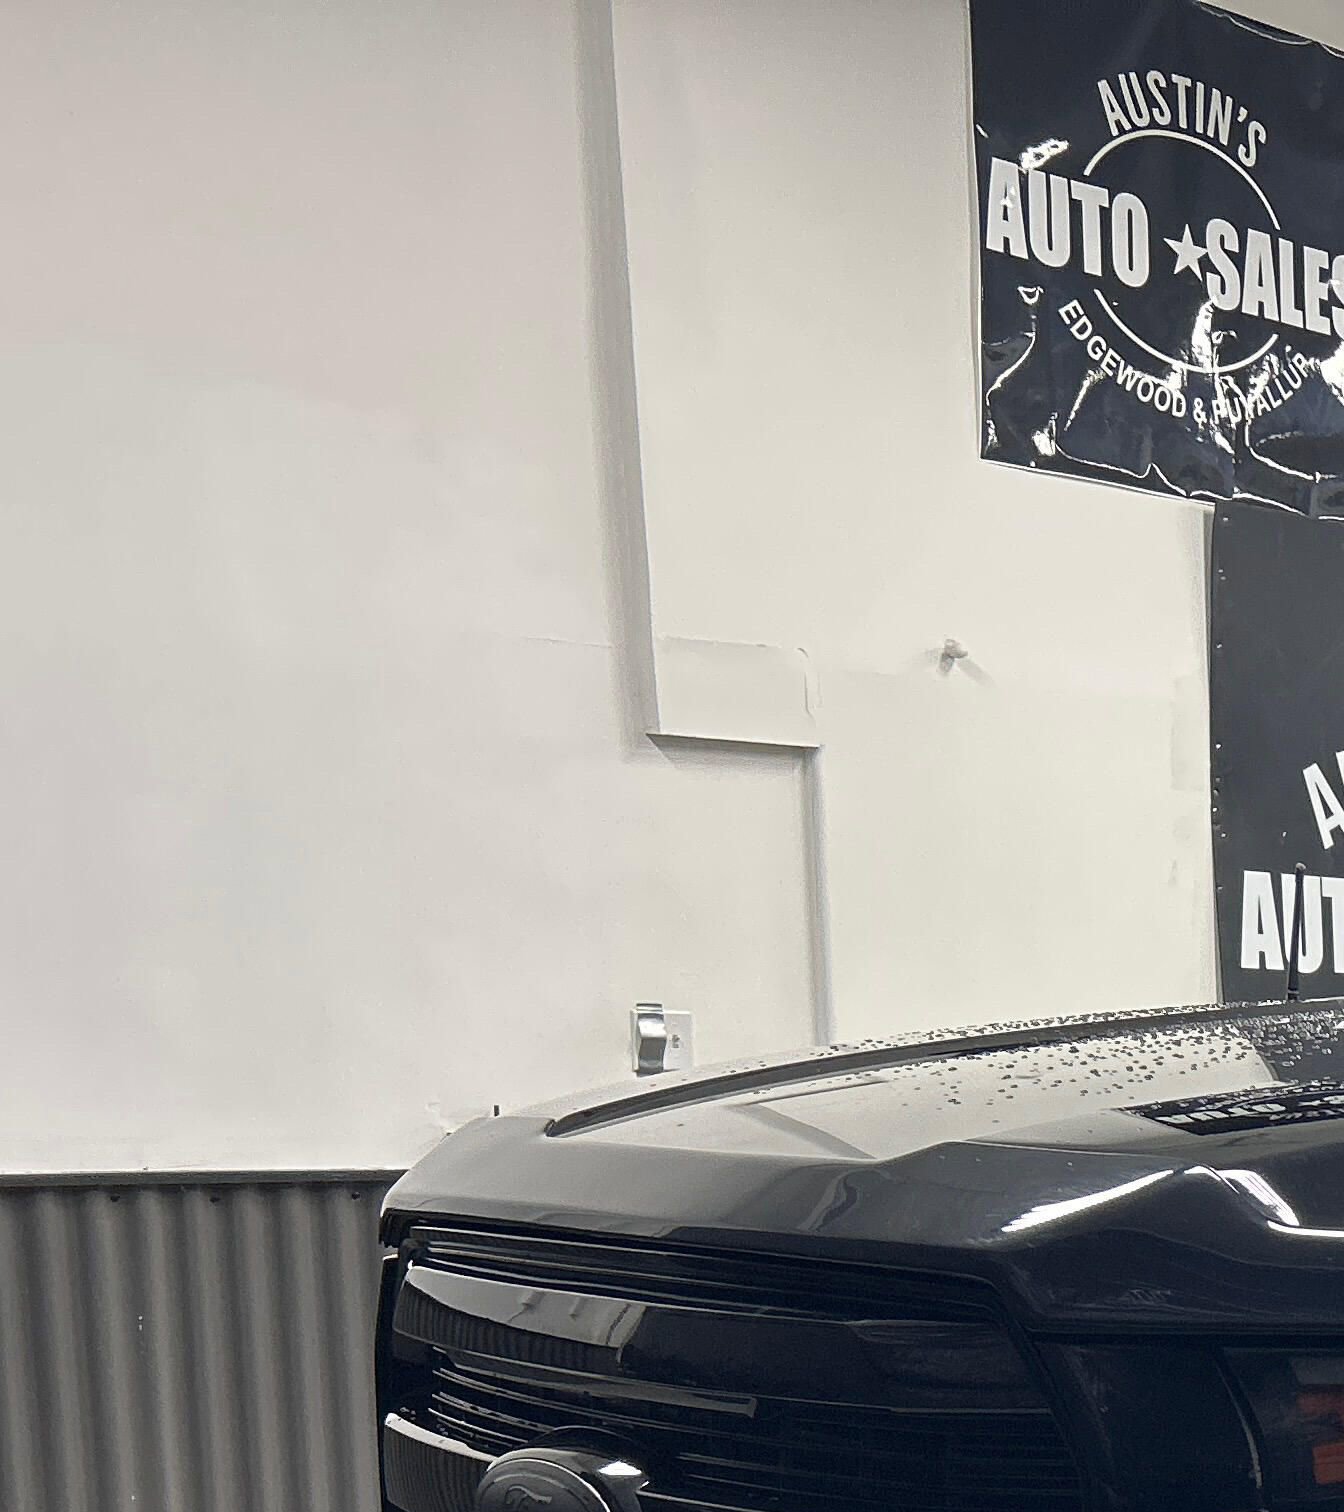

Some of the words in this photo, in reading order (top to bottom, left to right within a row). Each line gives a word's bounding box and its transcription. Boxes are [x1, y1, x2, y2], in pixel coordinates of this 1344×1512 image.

[1097, 70, 1267, 168] AUSTIN'S
[985, 156, 1151, 289] AUTO
[1057, 299, 1187, 419] EDGEWOOD
[1192, 397, 1208, 424] &
